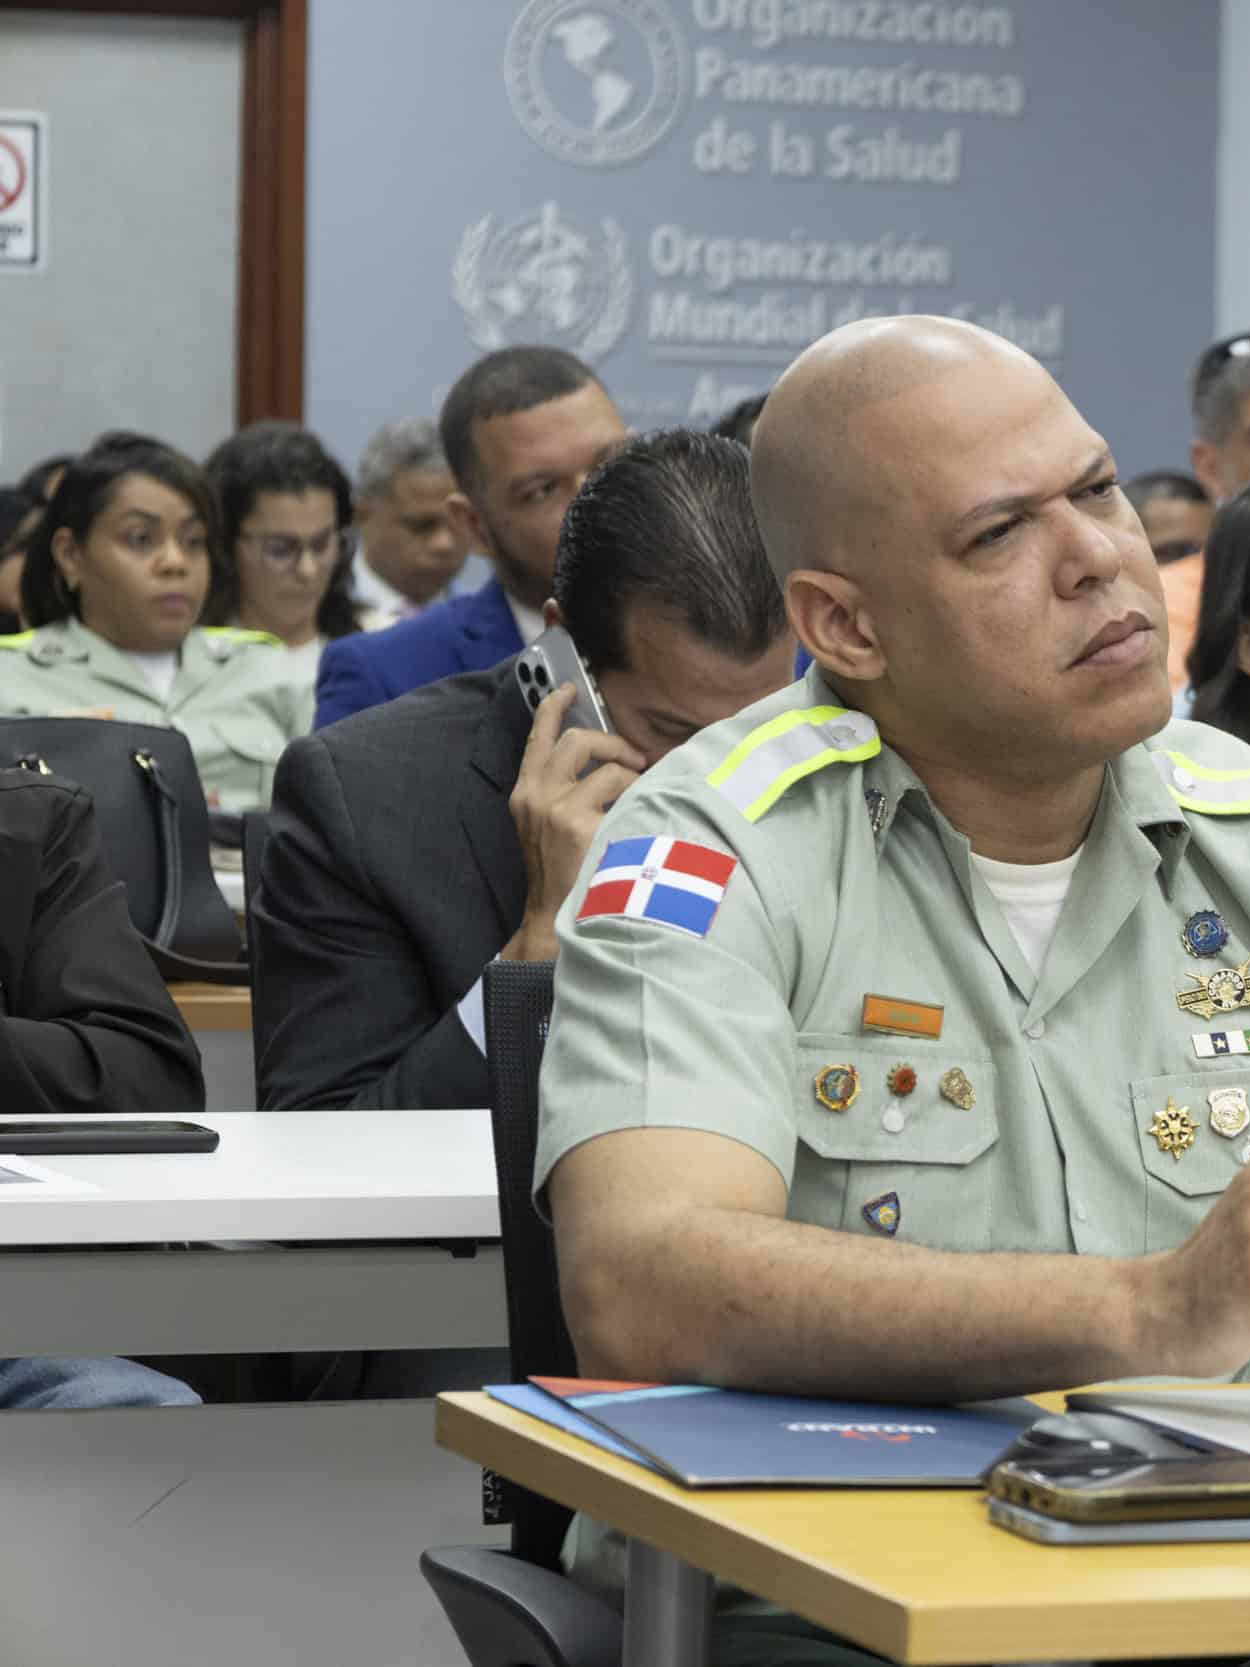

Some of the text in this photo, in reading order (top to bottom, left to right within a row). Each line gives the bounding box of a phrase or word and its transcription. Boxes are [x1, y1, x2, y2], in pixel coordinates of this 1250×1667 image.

[695, 47, 1024, 114] Panamericana
[693, 115, 962, 184] de la Salud
[650, 224, 953, 289] Organización
[648, 291, 825, 344] Mundial
